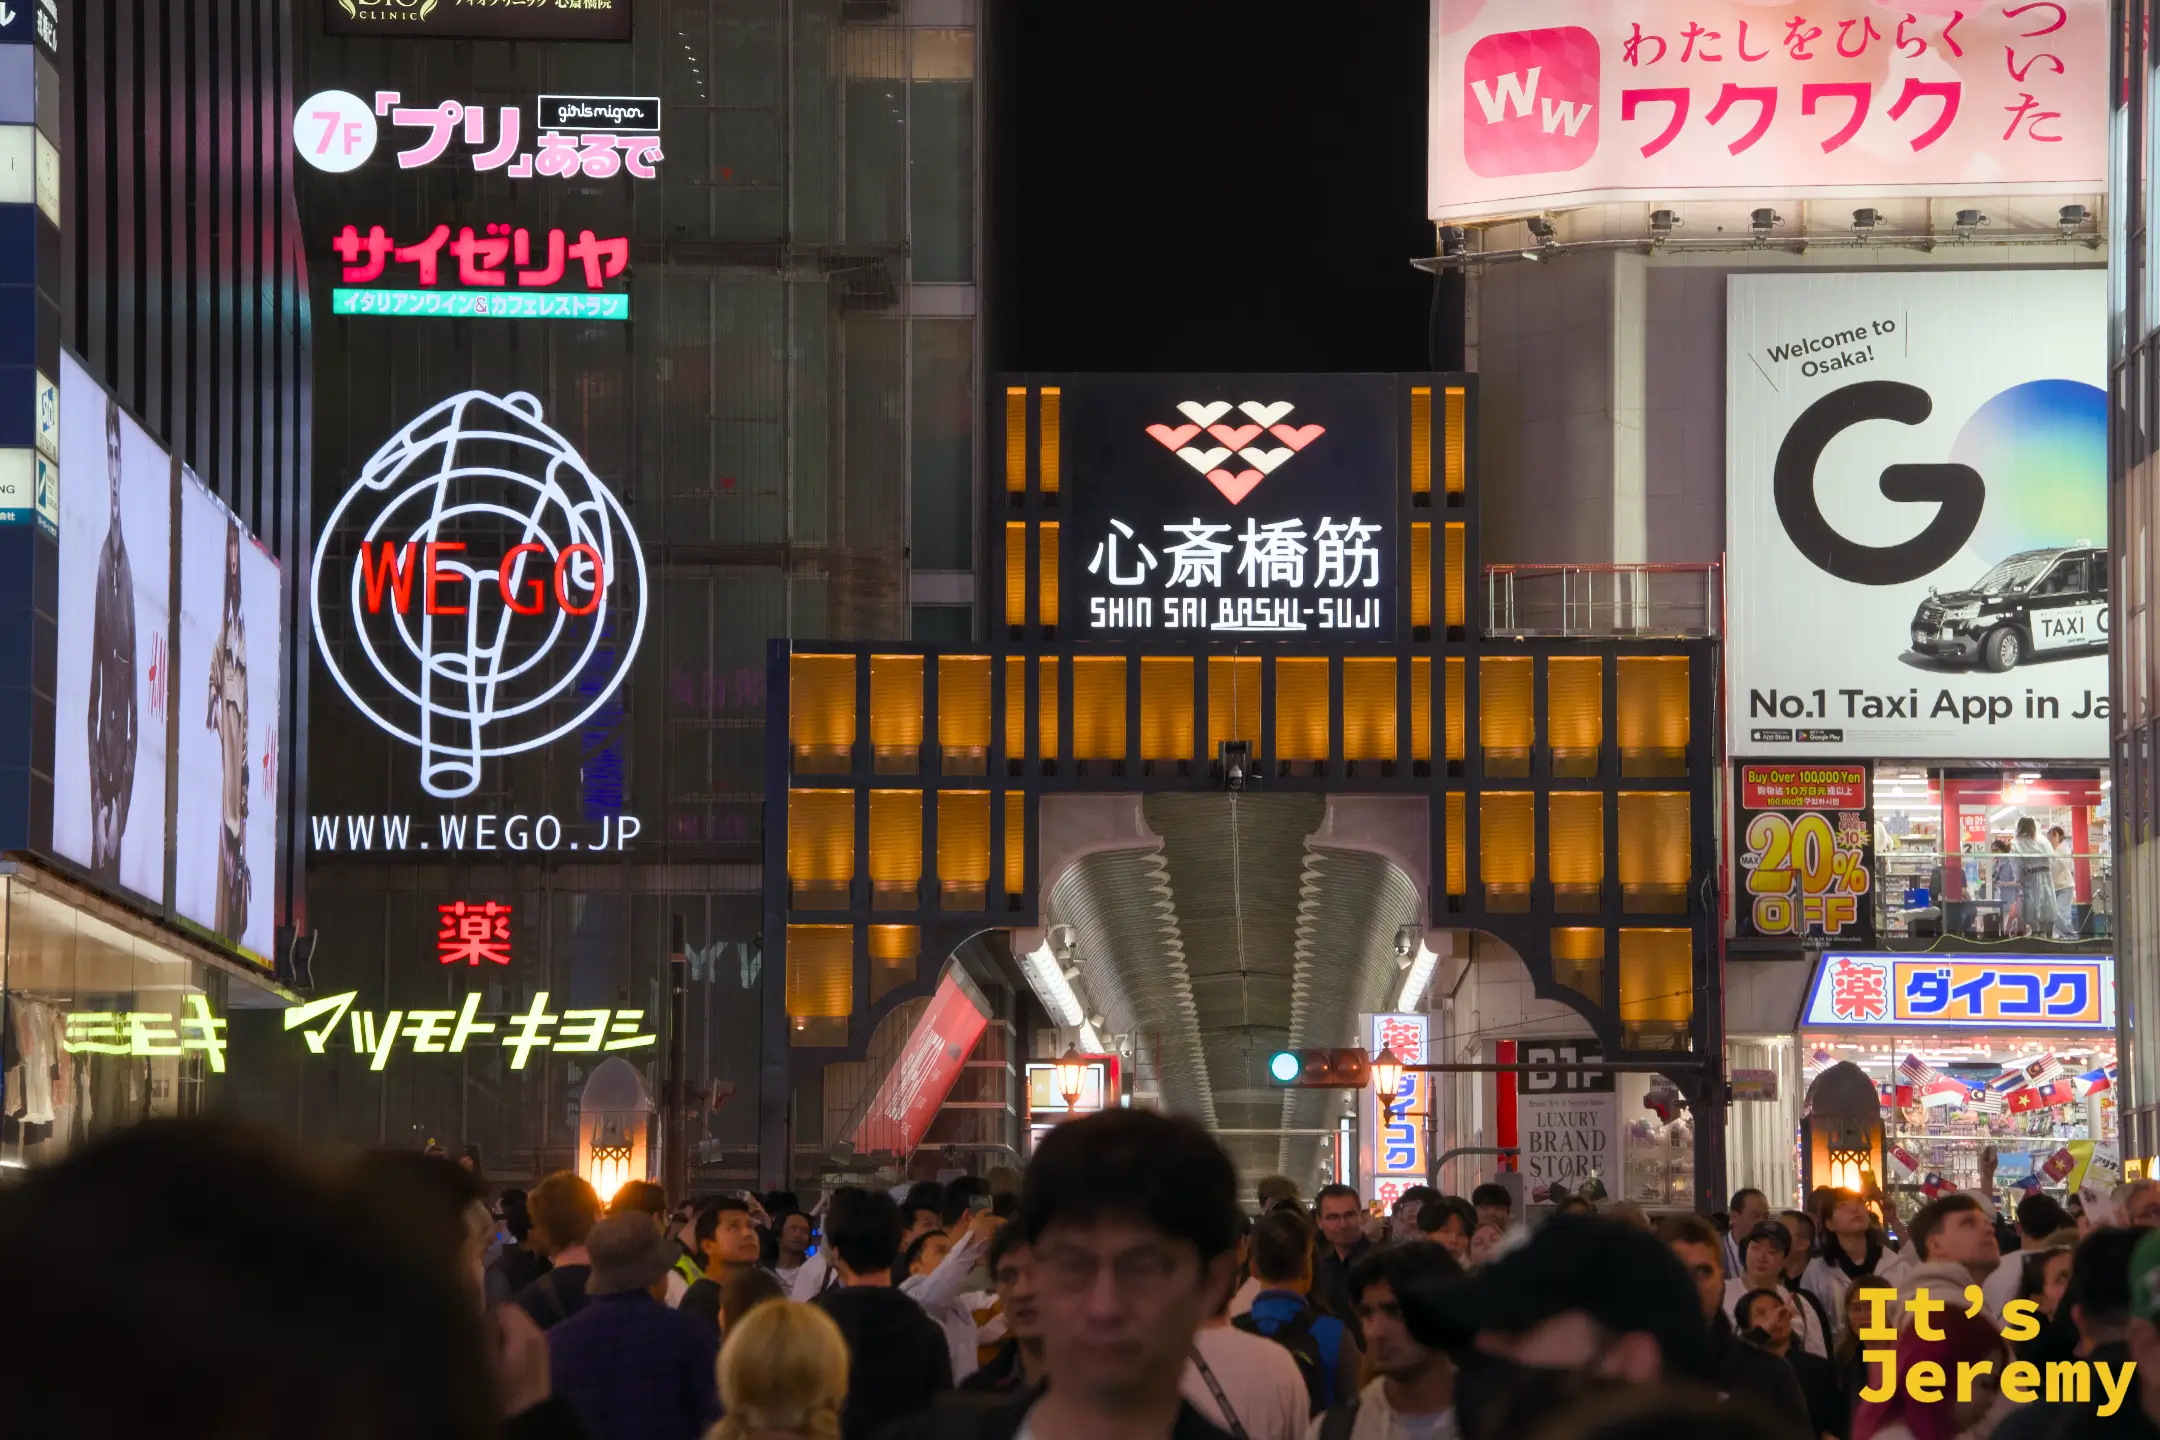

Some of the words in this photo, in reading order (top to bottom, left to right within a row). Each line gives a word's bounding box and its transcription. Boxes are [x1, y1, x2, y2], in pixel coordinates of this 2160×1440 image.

[359, 12, 418, 21] CLINIC
[1622, 10, 1964, 67] わたしをひらく
[2002, 1, 2067, 142] ついた
[312, 112, 362, 155] 7F
[1621, 77, 1962, 159] ワクワク
[333, 224, 629, 288] サイゼリヤ
[1766, 327, 1867, 363] Welcome
[1872, 320, 1896, 336] to
[1801, 345, 1874, 377] Osaka!
[1088, 516, 1383, 588] 心斎橋筋
[1091, 597, 1152, 628] SHIN
[1164, 597, 1207, 628] SAI
[2041, 616, 2084, 638] TAXI
[1750, 689, 1826, 719] No.1
[1839, 689, 1918, 719] Taxi
[1930, 689, 2013, 725] App
[2026, 688, 2059, 719] in
[1748, 770, 1769, 784] Buy
[1770, 770, 1795, 783] Over
[1799, 771, 1839, 784] 100,000
[1840, 771, 1860, 783] Yen
[312, 815, 641, 850] WWW.WEGO.JP
[1839, 812, 1860, 821] TAX
[1839, 821, 1866, 830] FREE
[1741, 856, 1760, 865] MAX
[1747, 813, 1868, 895] 20%
[1753, 894, 1857, 934] OFF
[438, 901, 512, 966] 薬
[1833, 959, 1886, 1018] 薬
[1906, 968, 2088, 1016] ダイコク
[285, 990, 657, 1070] マツモトキヨシ
[1537, 1111, 1599, 1128] LUXURY
[1529, 1130, 1607, 1153] BRAND
[1529, 1155, 1605, 1178] STORE
